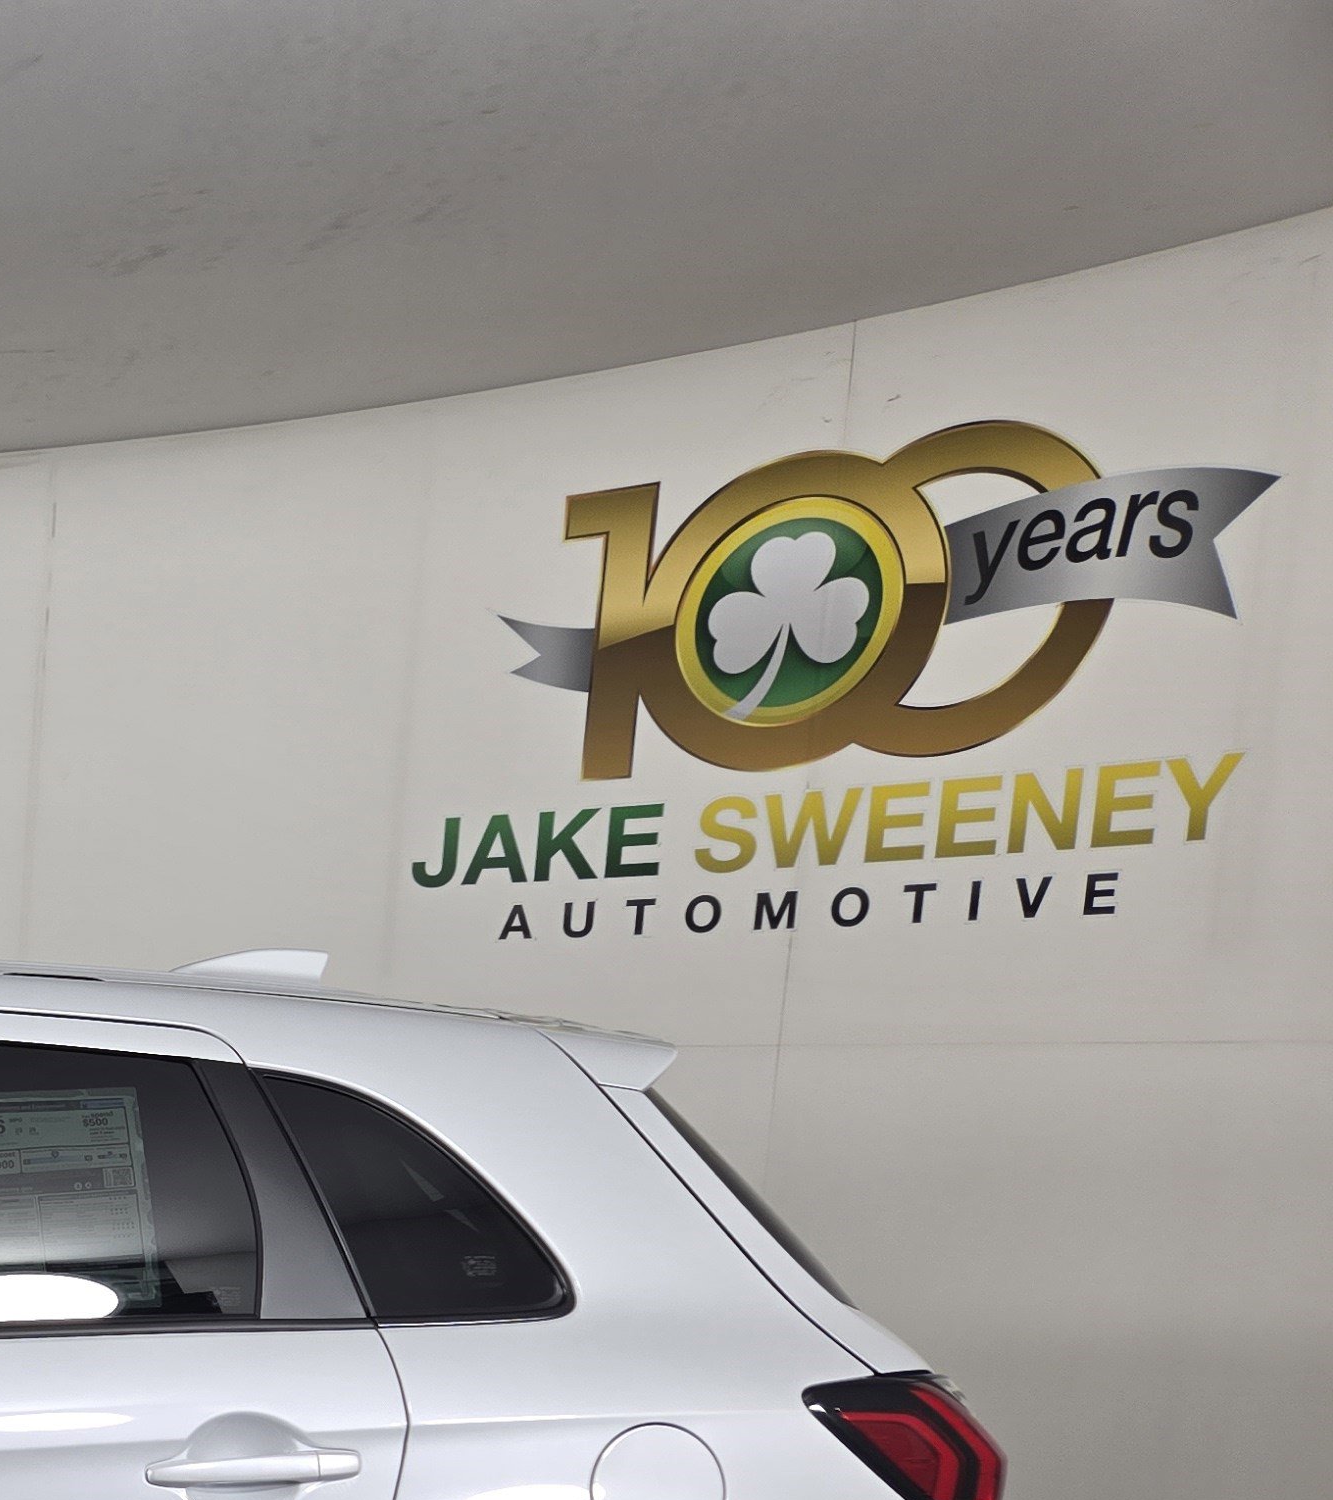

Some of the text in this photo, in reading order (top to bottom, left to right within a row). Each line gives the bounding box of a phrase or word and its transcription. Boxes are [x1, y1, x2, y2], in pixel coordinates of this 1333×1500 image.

[563, 419, 1200, 781] 100 years
[412, 752, 1246, 890] JAKE SWEENEY
[499, 871, 1121, 941] AUTOMOTIVE
